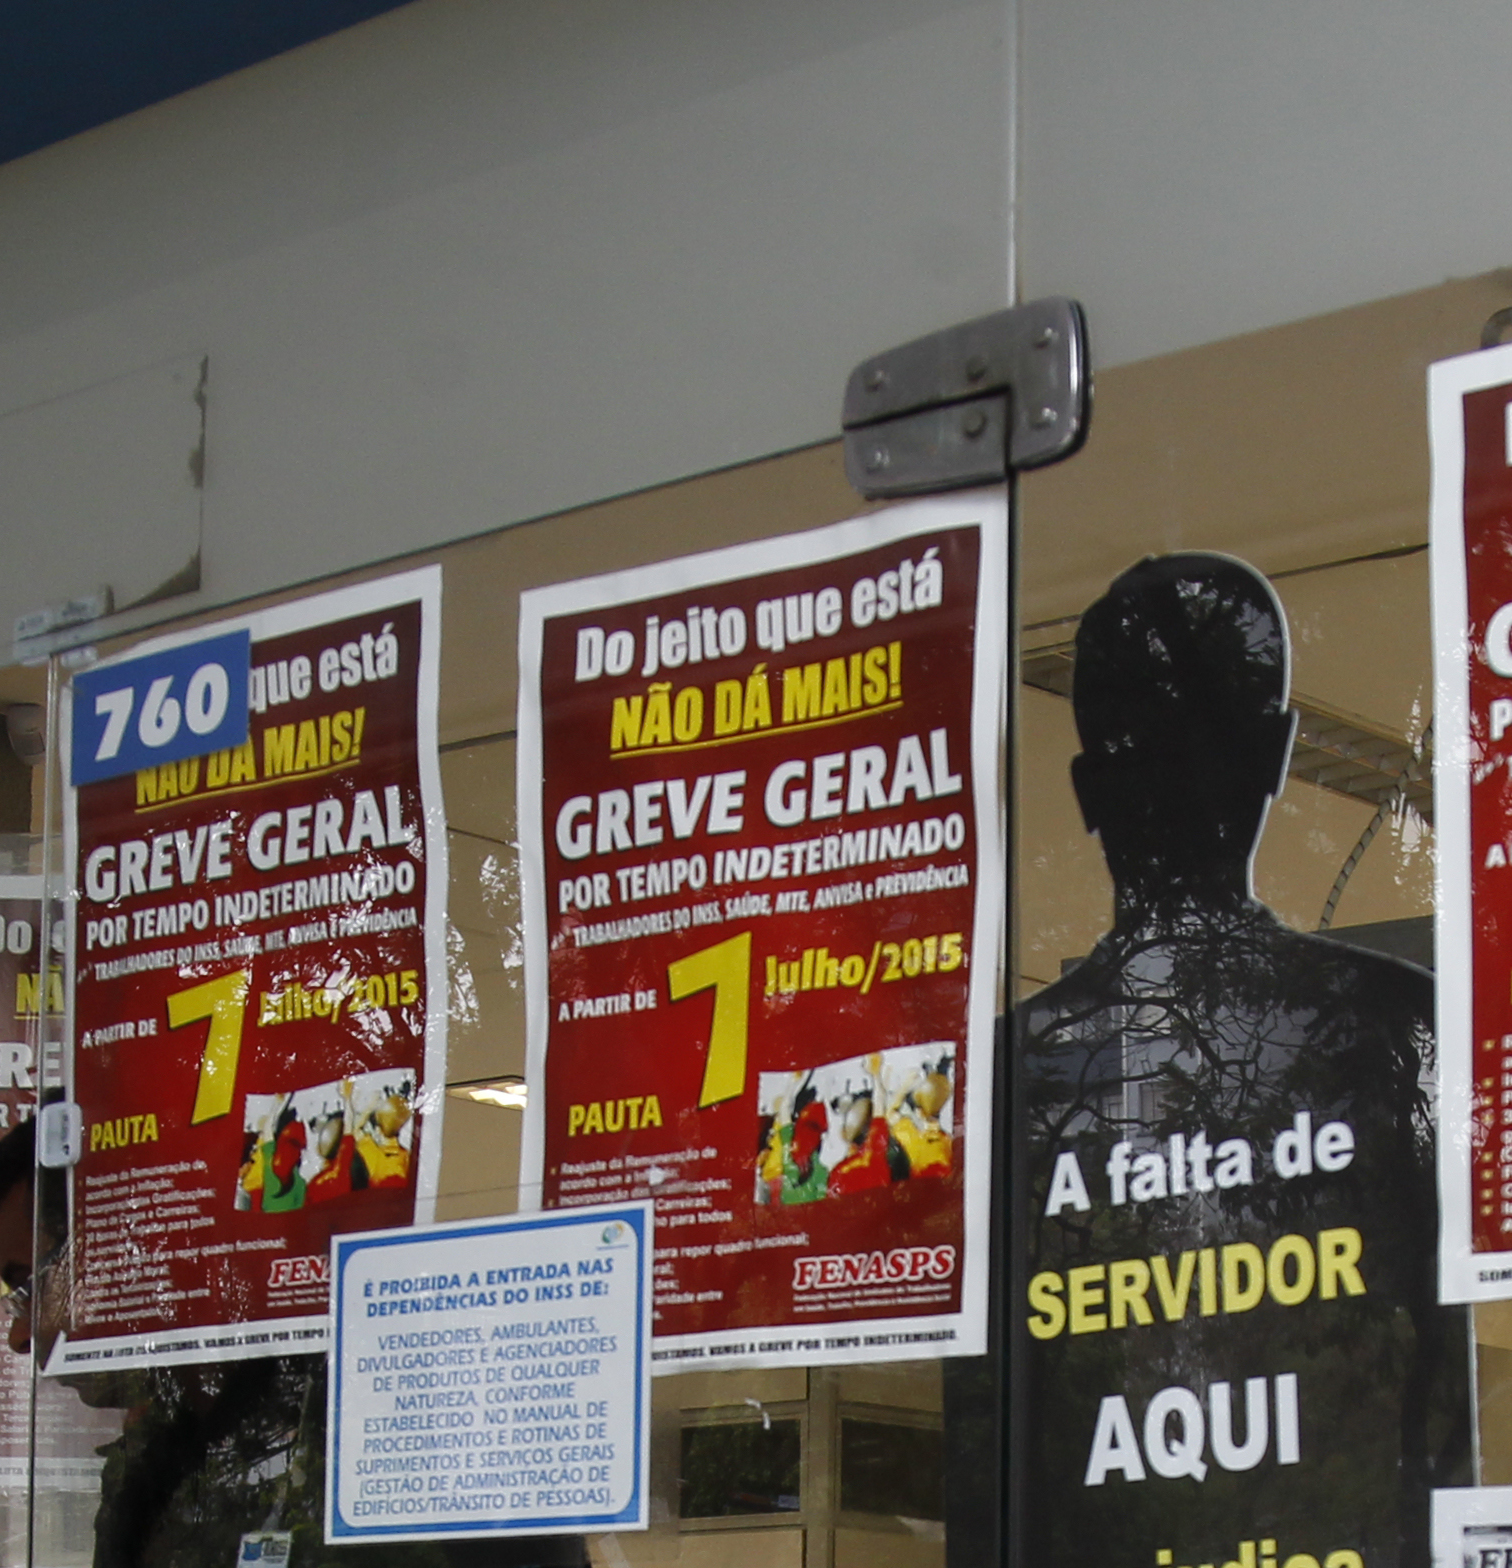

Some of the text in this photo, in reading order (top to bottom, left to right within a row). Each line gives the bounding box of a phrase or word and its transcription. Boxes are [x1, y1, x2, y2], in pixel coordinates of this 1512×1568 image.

[575, 547, 943, 681] Do jeito que está
[94, 663, 230, 763] 760
[1045, 1111, 1356, 1217] A falta de
[364, 1258, 613, 1297] É PROIBIDA A ENTRADA NAS
[1026, 1227, 1366, 1342] SERVIDOR
[367, 1282, 608, 1317] DEPENDÊNCIAS DO INSS DE:
[357, 1336, 617, 1372] DIVULGADORES E AGENCIADORES
[374, 1359, 600, 1392] DE PRODUTOS DE QUALQUER
[486, 1382, 575, 1404] CONFORME
[364, 1402, 607, 1433] ESTABELECIDO NO MANUAL DE
[1085, 1372, 1301, 1486] AQUI
[363, 1423, 607, 1453] PROCEDIMENTOS E ROTINAS DE
[356, 1444, 614, 1475] SUPRIMENTOS E SERVIÇOS GERAIS
[428, 1476, 448, 1492] DE
[454, 1467, 583, 1491] ADMINISTRAÇÃO
[589, 1466, 610, 1482] DE
[511, 1492, 531, 1508] DE
